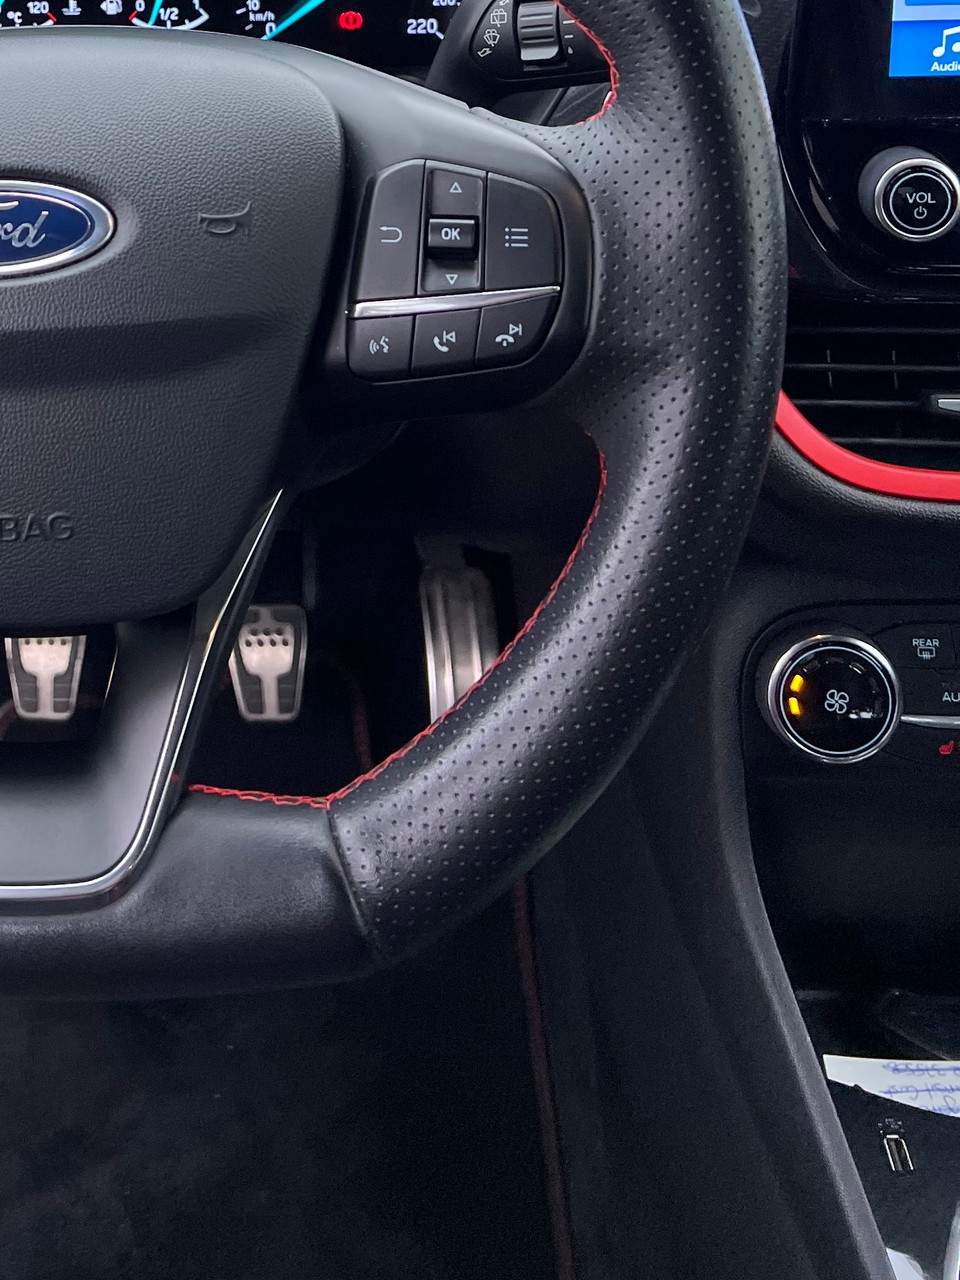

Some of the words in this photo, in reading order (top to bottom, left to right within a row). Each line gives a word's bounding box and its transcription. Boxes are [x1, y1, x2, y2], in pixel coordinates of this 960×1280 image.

[26, 1, 49, 14] 120
[135, 0, 146, 12] 0
[246, 0, 260, 11] 10
[159, 7, 179, 21] 1/2
[249, 10, 275, 22] km/h
[407, 18, 438, 34] 220
[930, 61, 960, 72] Audi
[906, 192, 936, 204] VOL
[441, 228, 461, 241] OK
[912, 638, 940, 647] REAR
